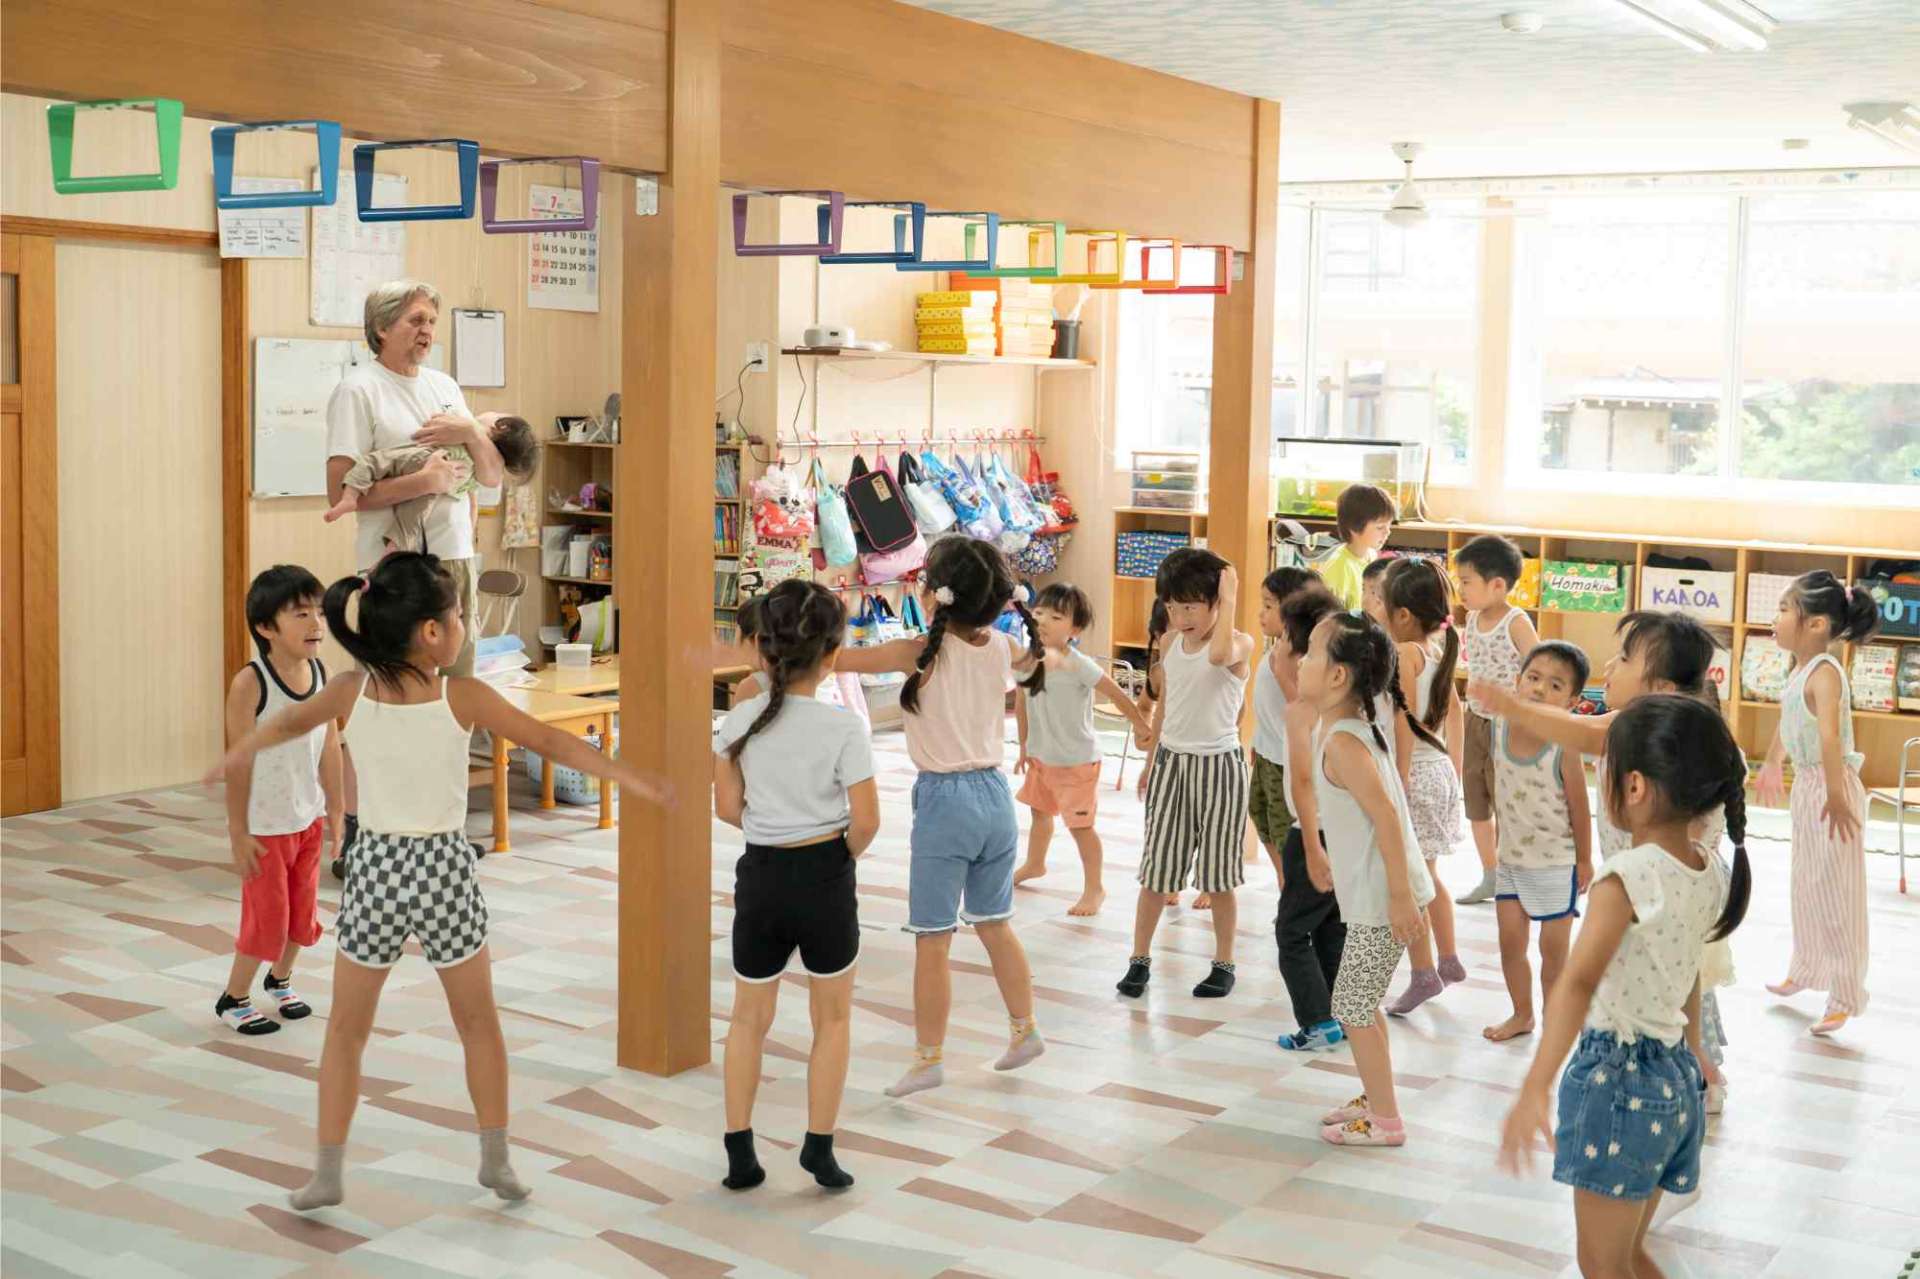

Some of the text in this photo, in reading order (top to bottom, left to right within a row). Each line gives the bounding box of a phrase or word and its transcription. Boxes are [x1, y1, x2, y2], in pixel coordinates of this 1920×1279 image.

[551, 195, 558, 209] 7
[570, 231, 577, 240] 10
[542, 243, 549, 252] 14
[551, 244, 558, 254] 15
[560, 245, 567, 254] 16
[569, 246, 577, 255] 17
[579, 247, 586, 256] 18
[550, 260, 559, 269] 22
[559, 261, 568, 270] 23
[569, 262, 577, 271] 24
[578, 263, 587, 272] 25
[541, 275, 549, 284] 28
[550, 276, 559, 285] 29
[559, 276, 568, 285] 30
[568, 278, 577, 286] 31
